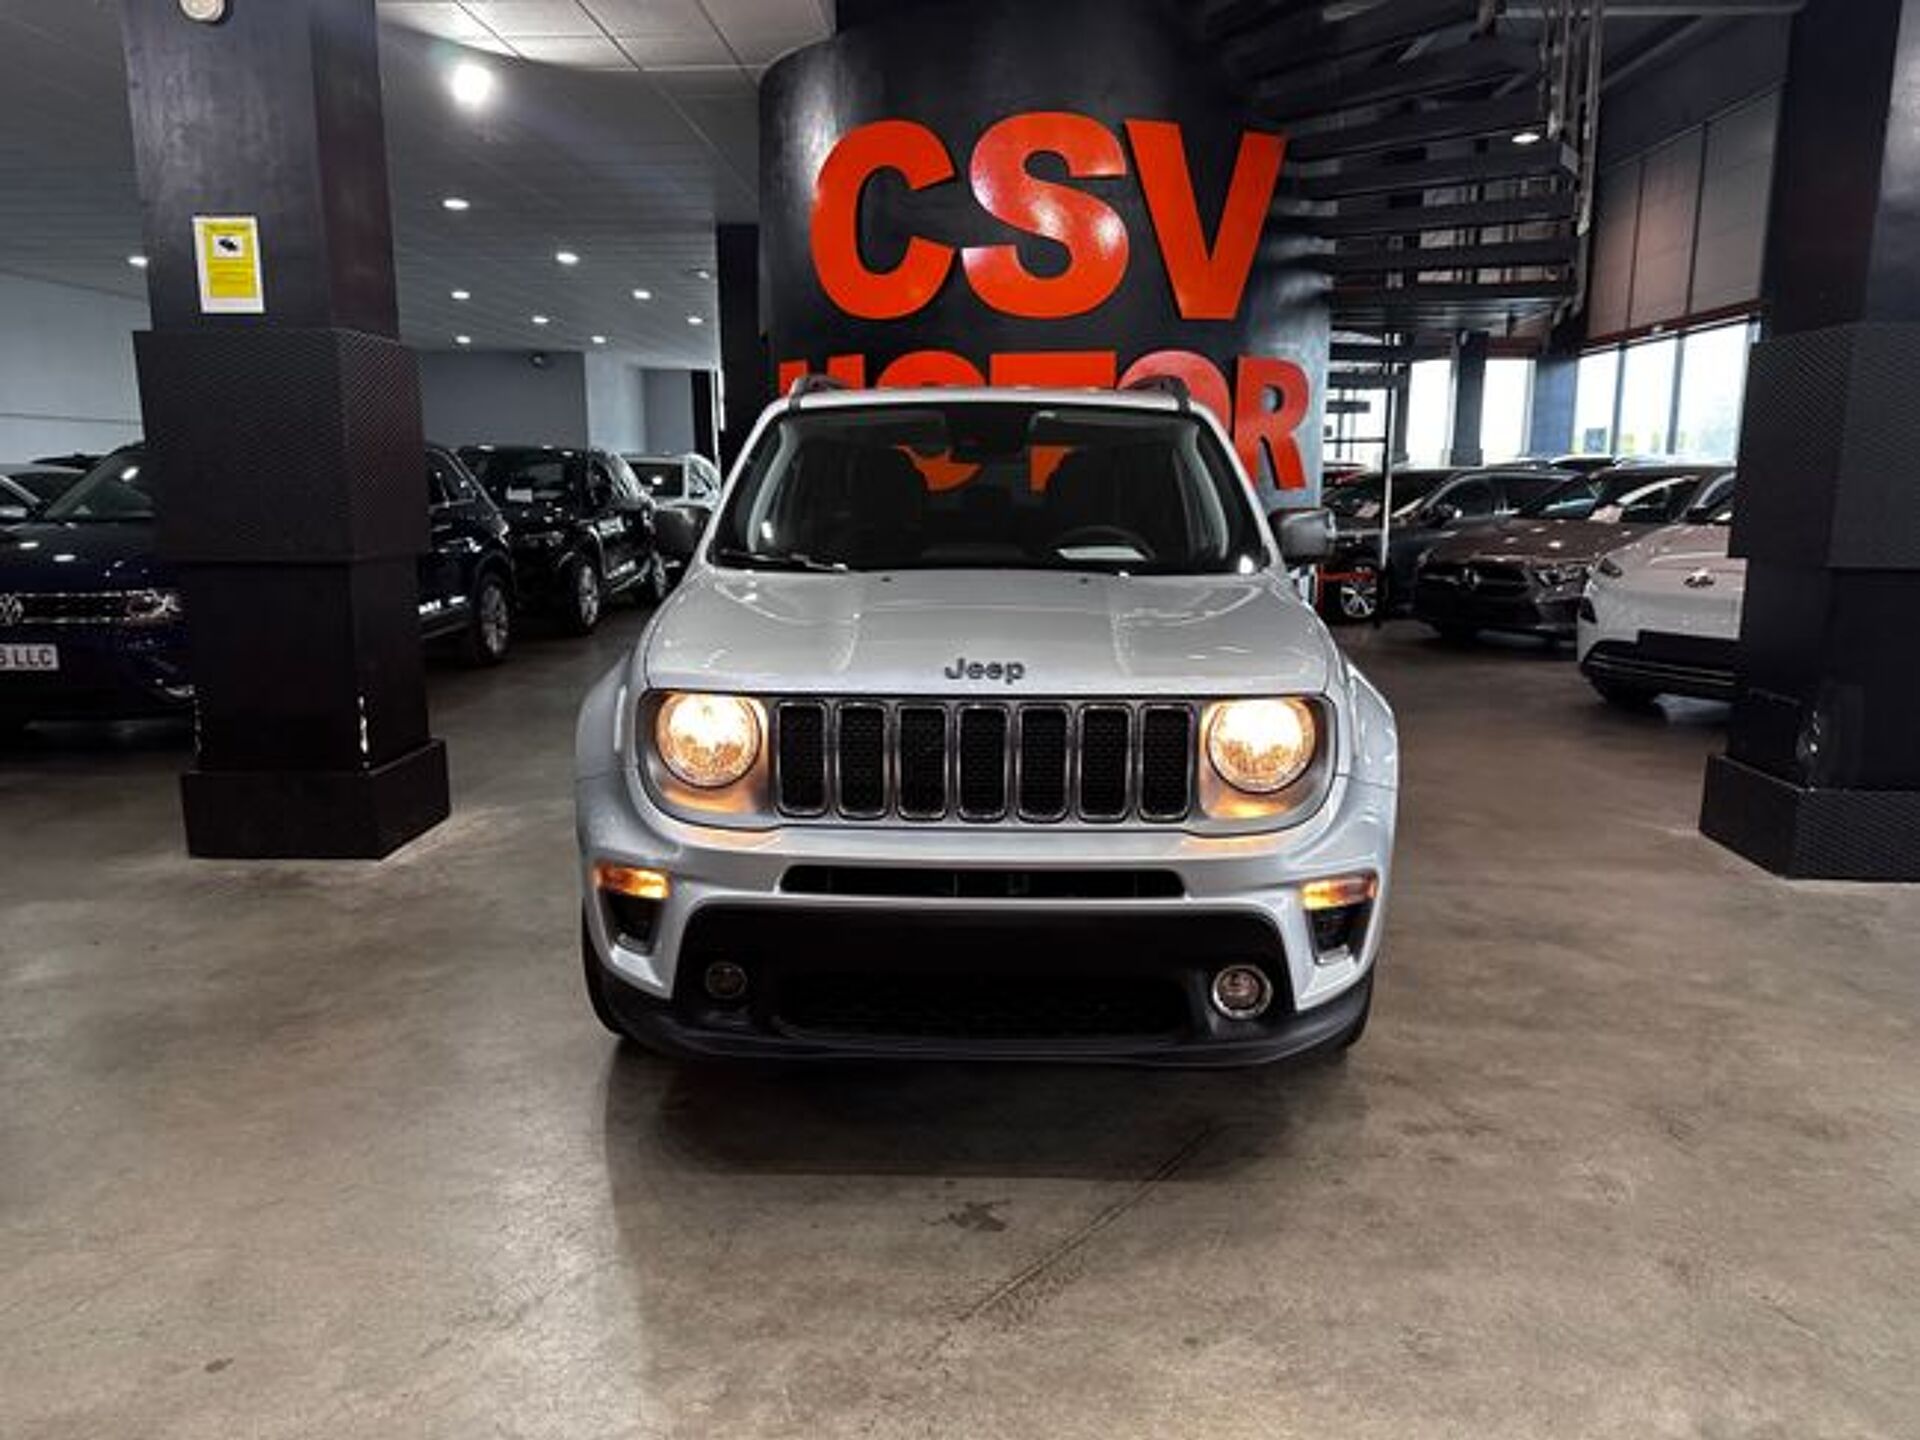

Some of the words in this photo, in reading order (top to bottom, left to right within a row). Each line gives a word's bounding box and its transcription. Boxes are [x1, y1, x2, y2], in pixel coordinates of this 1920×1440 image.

[809, 111, 1288, 320] CSV
[13, 648, 52, 665] LLC
[944, 657, 1025, 685] Jeep
